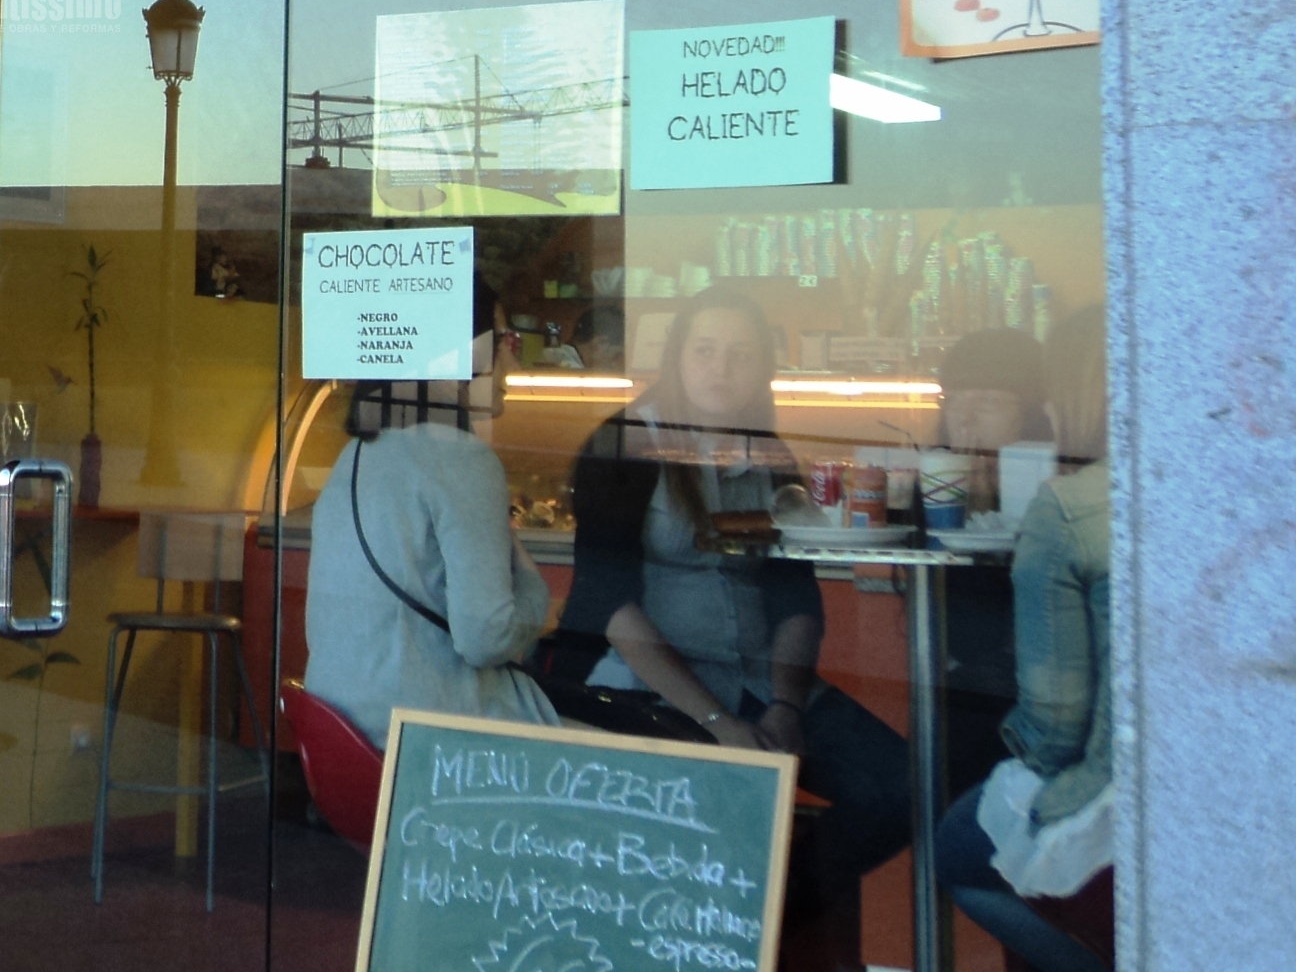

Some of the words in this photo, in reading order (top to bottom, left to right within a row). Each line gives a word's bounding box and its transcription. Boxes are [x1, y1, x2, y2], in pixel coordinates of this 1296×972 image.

[682, 67, 787, 98] HELADO
[667, 109, 800, 141] CALIENTE
[317, 240, 455, 270] CHOCOLATE
[319, 278, 381, 294] CALIENTE
[388, 277, 454, 292] ARTESANO
